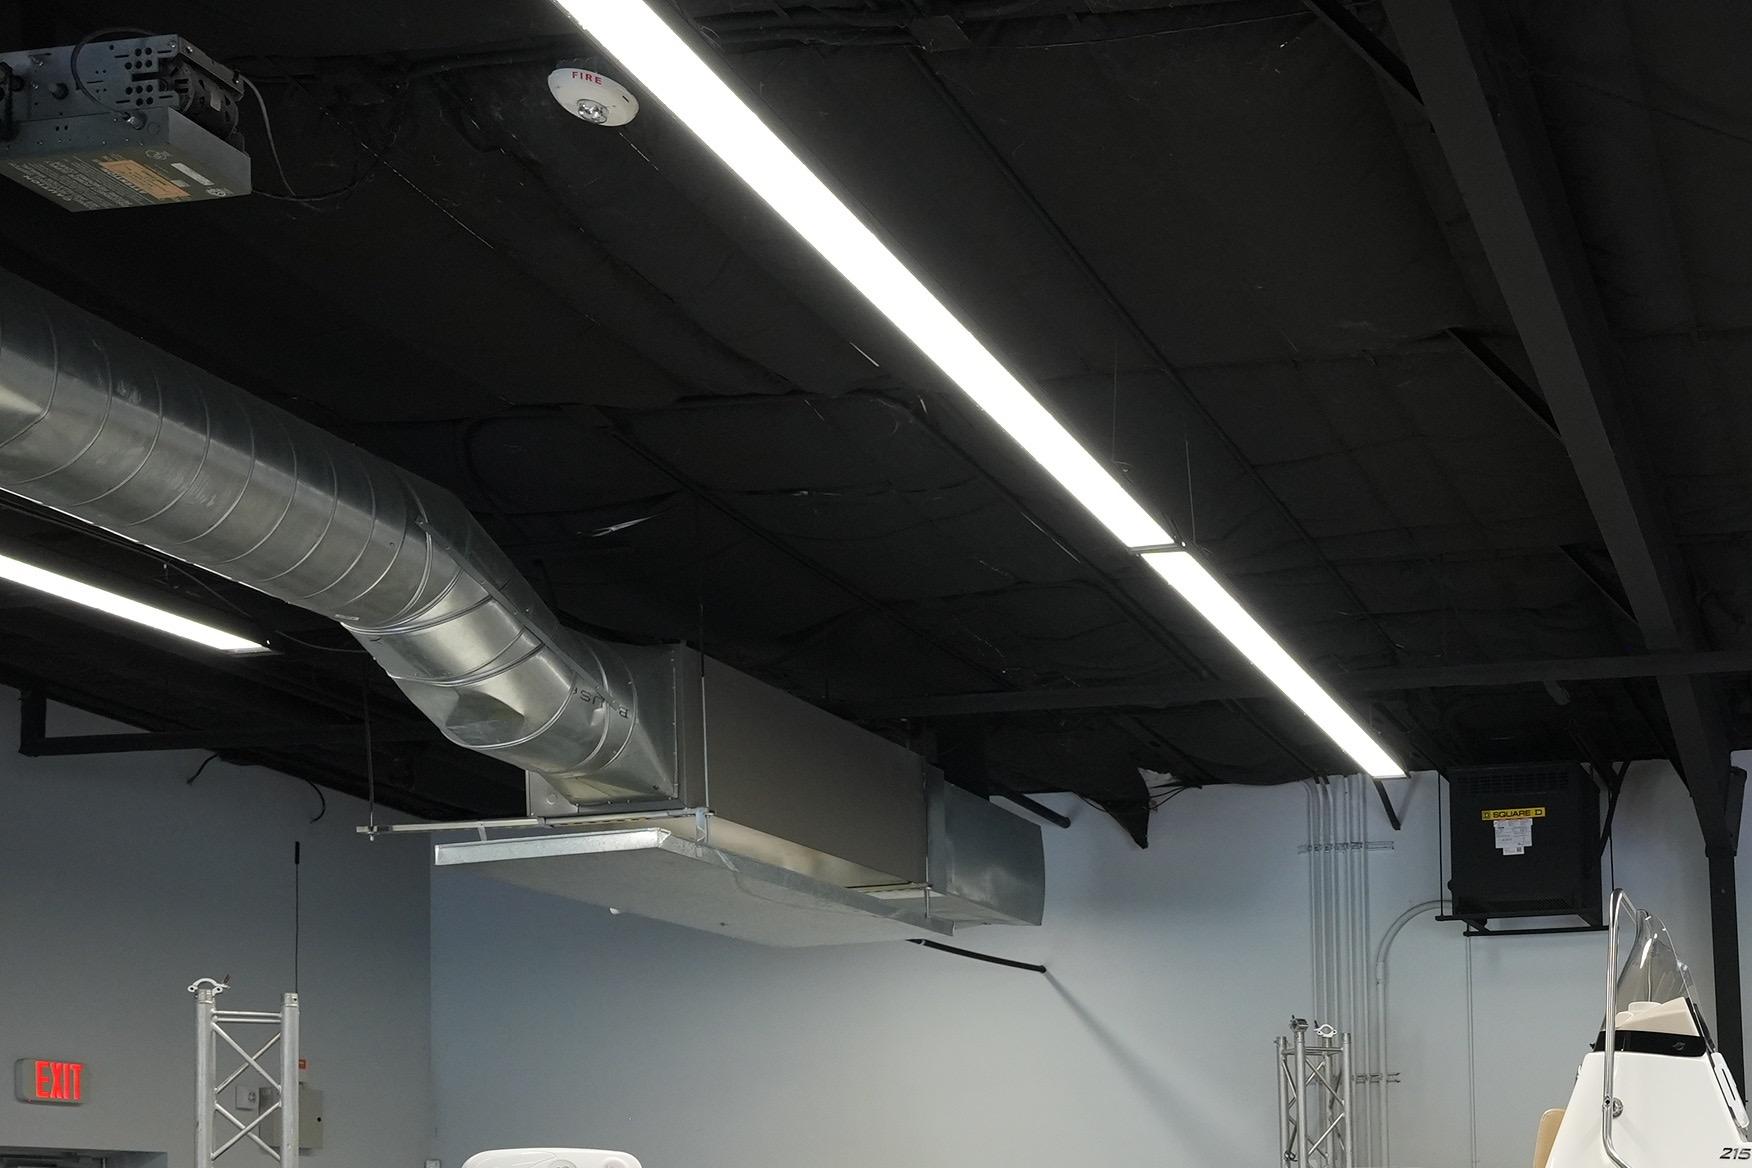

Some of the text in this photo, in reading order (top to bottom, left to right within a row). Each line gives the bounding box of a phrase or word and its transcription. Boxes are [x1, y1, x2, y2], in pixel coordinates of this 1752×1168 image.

[571, 71, 602, 86] FIRE
[1493, 810, 1531, 818] SQUARE
[36, 1061, 84, 1100] EXIT
[1719, 1147, 1752, 1160] 215
